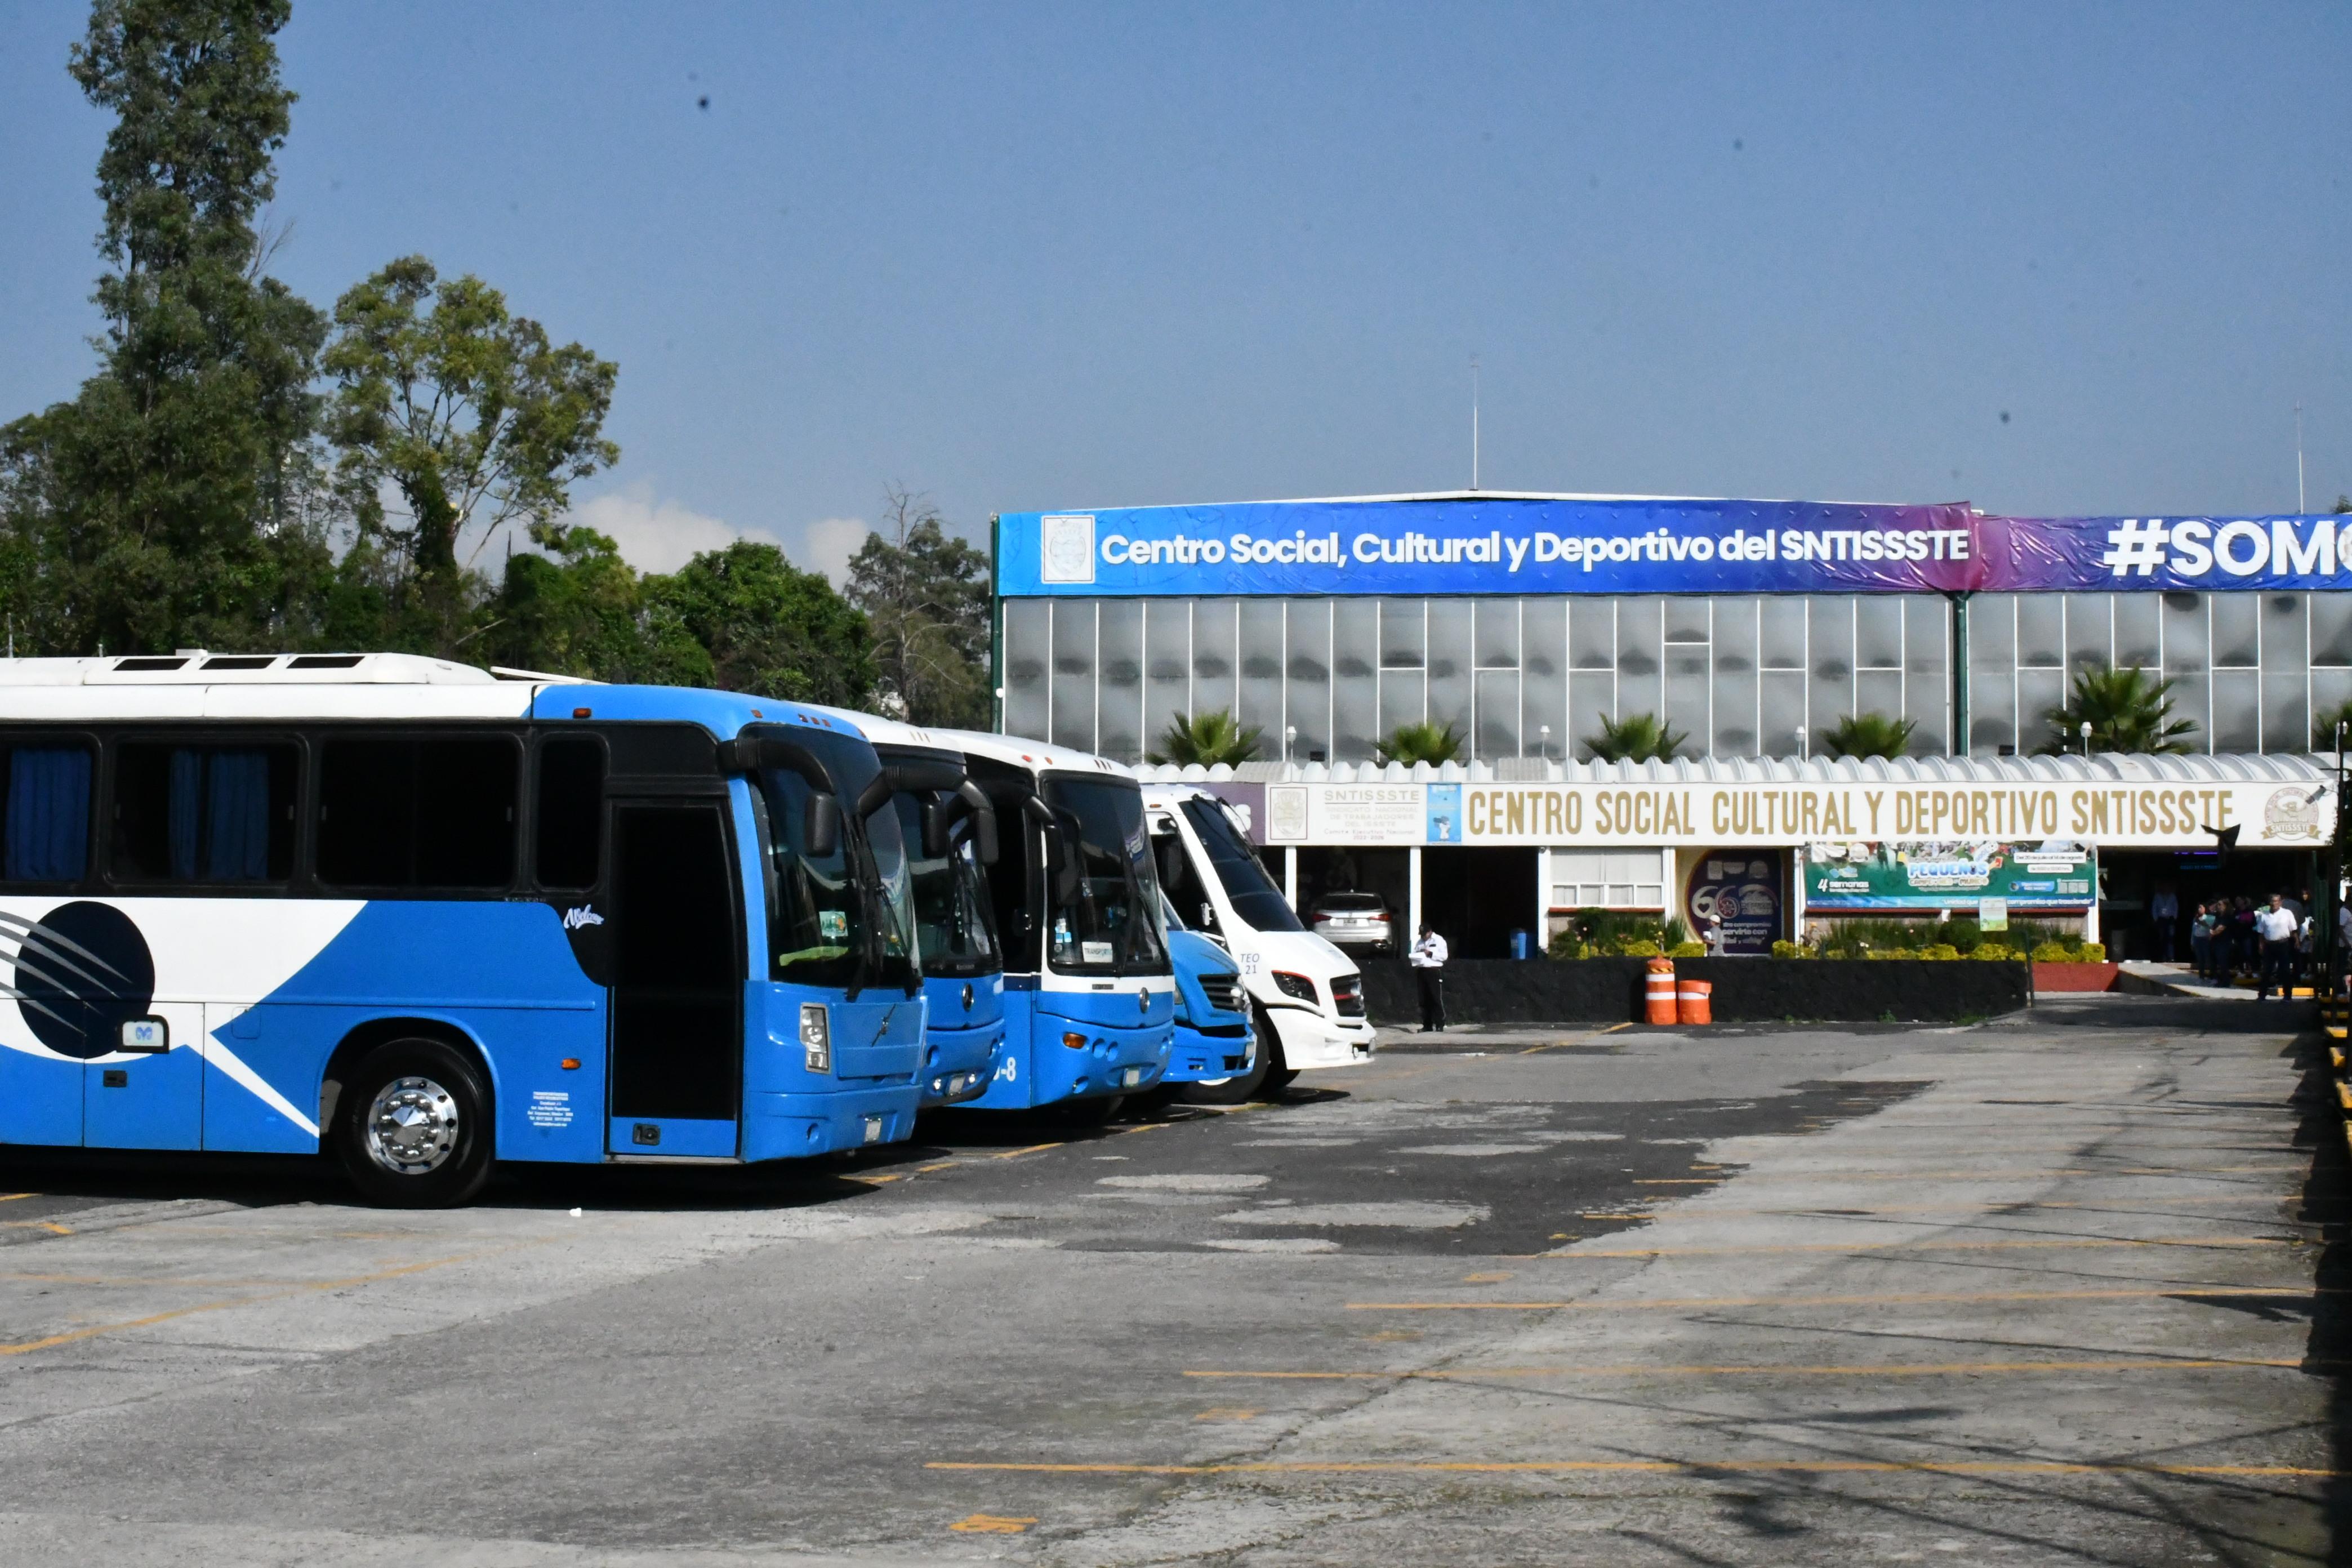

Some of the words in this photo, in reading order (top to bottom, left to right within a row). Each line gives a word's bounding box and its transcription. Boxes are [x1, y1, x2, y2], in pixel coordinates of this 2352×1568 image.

[1102, 535, 1226, 564] Centro
[1231, 531, 1348, 568] Social,
[1353, 531, 1500, 564] Cultural
[1505, 538, 1531, 573] y
[1535, 528, 1715, 572] Deportivo
[1719, 529, 1776, 562] del
[1781, 529, 1969, 562] SNTISSSTE
[2101, 519, 2352, 576] #SOM
[1324, 790, 1419, 801] SNTISSSTE
[1469, 792, 1582, 835] CENTRO
[1596, 792, 1695, 835] SOCIAL
[1712, 792, 1856, 835] CULTURAL
[1865, 791, 1884, 834] Y
[1896, 791, 2057, 835] DEPORTIVO
[2072, 791, 2232, 834] SNTISSSTE
[1817, 878, 1828, 893] 4
[1241, 953, 1260, 963] TEO
[1246, 965, 1257, 974] 21
